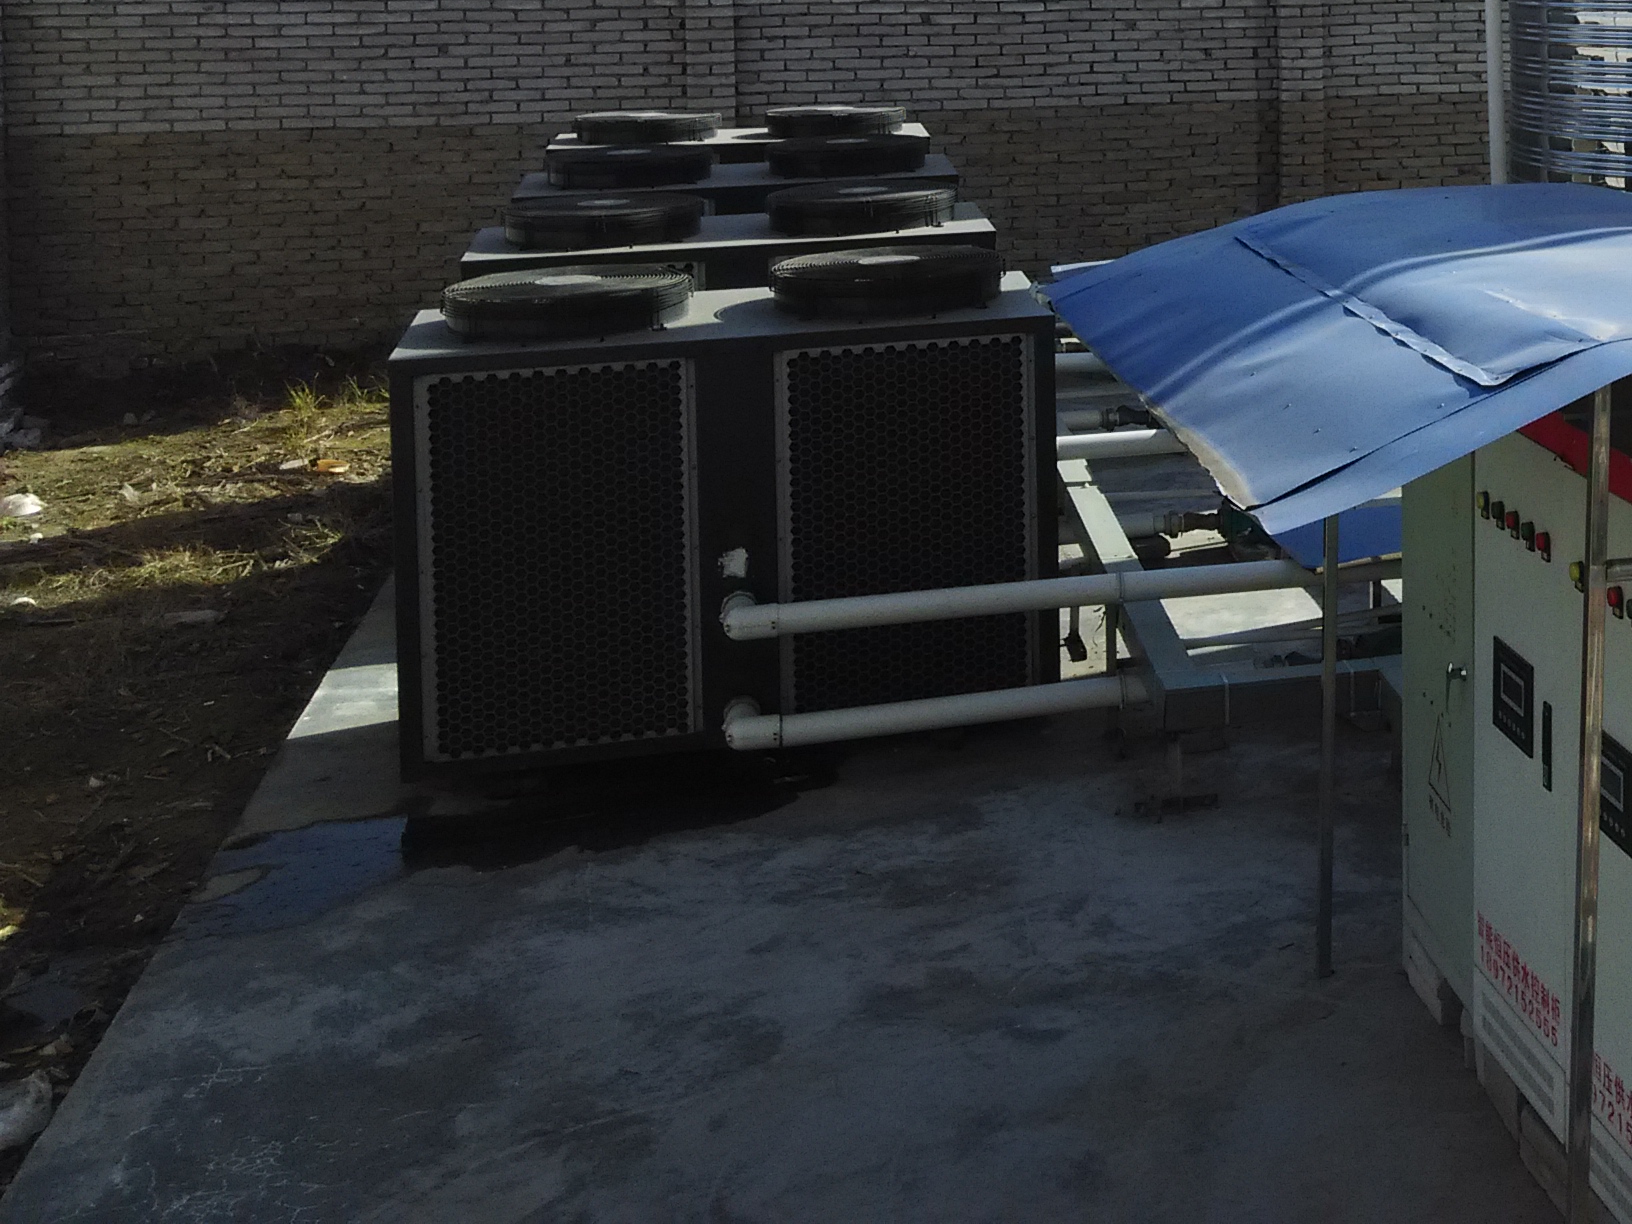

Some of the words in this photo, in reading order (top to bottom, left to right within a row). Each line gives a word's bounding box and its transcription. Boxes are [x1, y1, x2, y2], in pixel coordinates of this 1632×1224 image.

[1477, 909, 1561, 1025] 智能恒压供水控制柜
